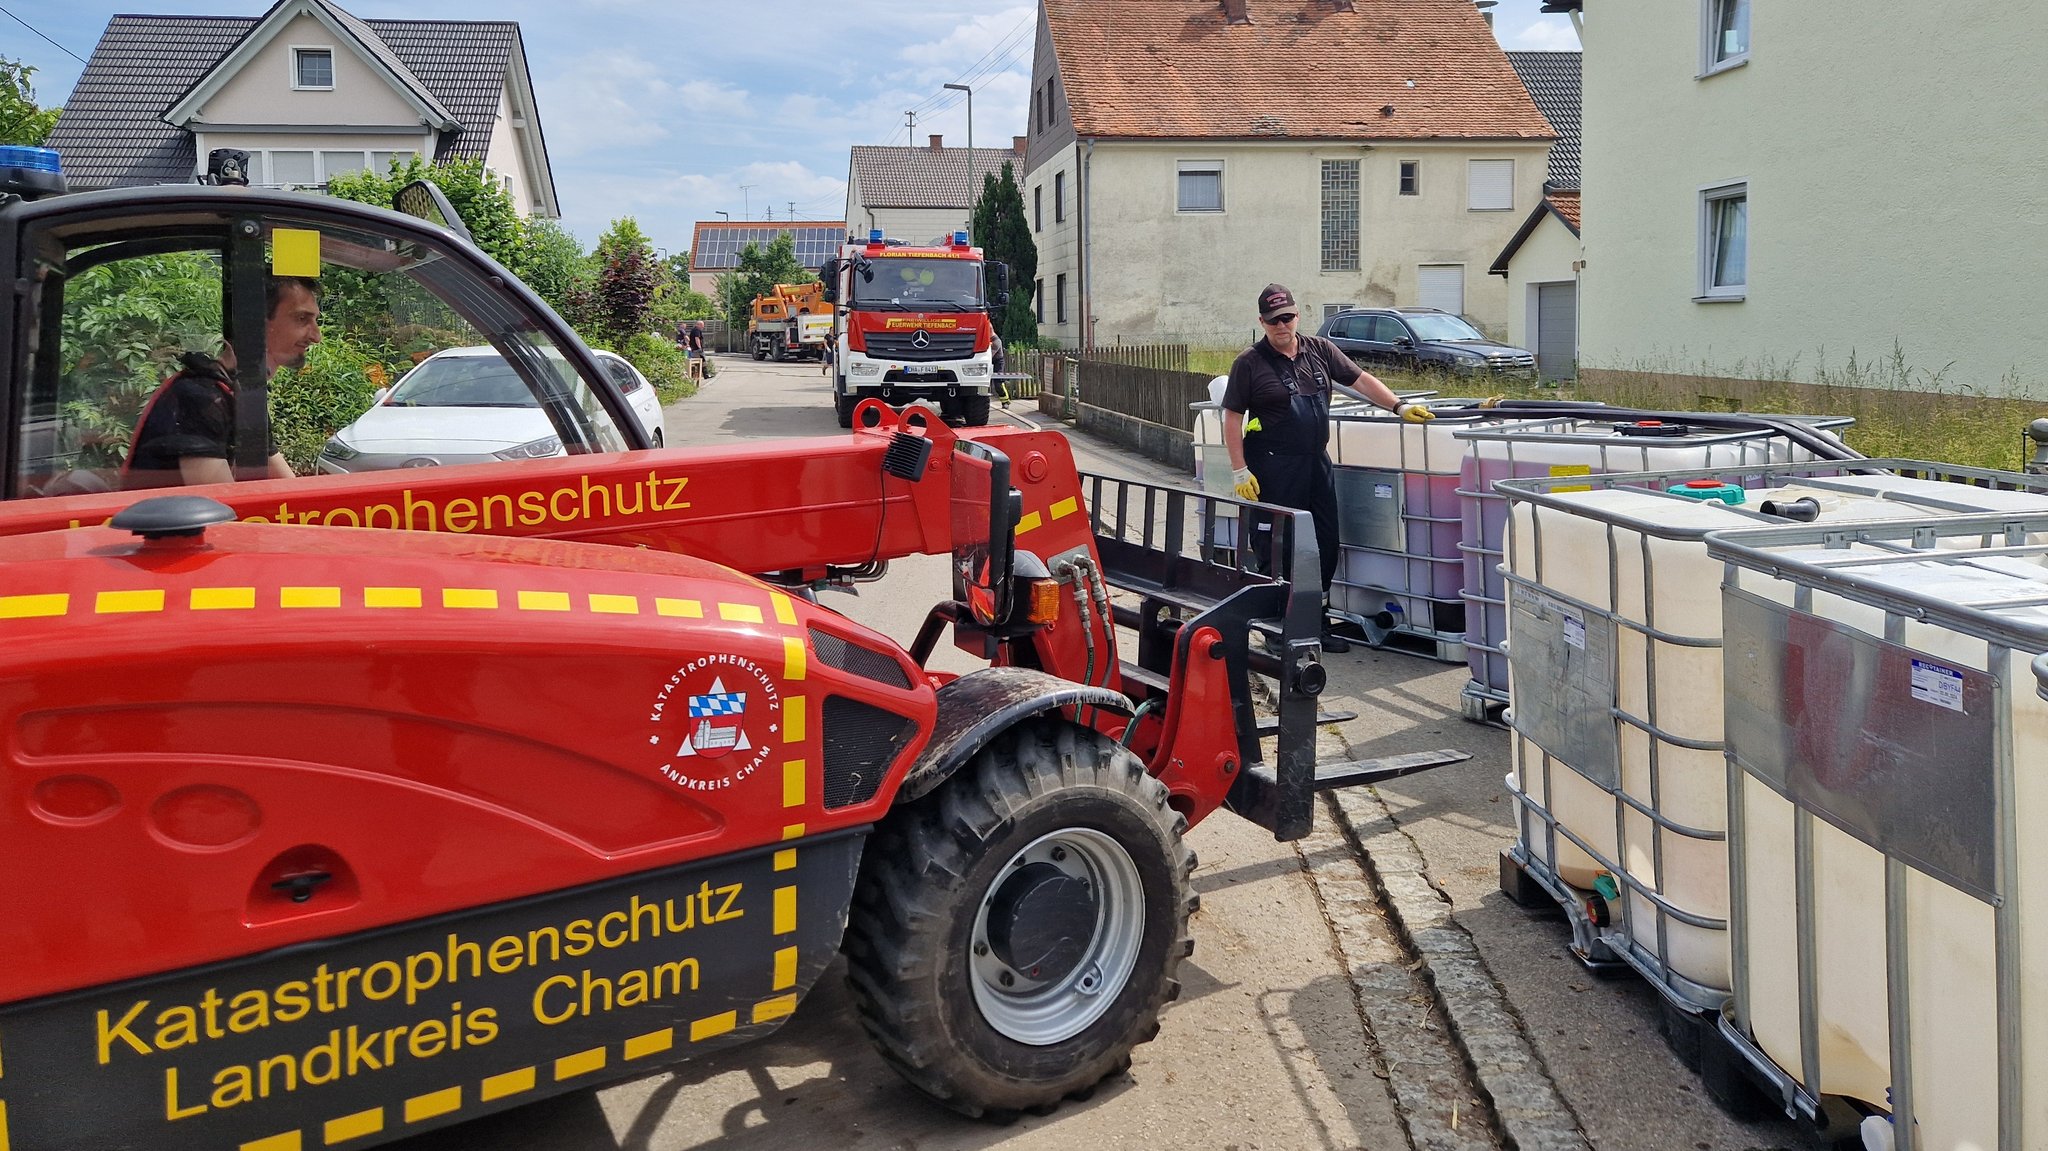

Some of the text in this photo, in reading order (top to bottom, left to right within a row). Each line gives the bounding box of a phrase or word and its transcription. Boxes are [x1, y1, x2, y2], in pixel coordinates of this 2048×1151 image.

[886, 318, 923, 328] FEUERWEHR
[69, 471, 691, 533] trophenschutz
[650, 654, 779, 721] KATASTROPHENSCHUTZ
[736, 745, 771, 780] CHAM
[97, 880, 745, 1065] Katastrophenschutz
[165, 957, 702, 1121] Landkreis Cham
